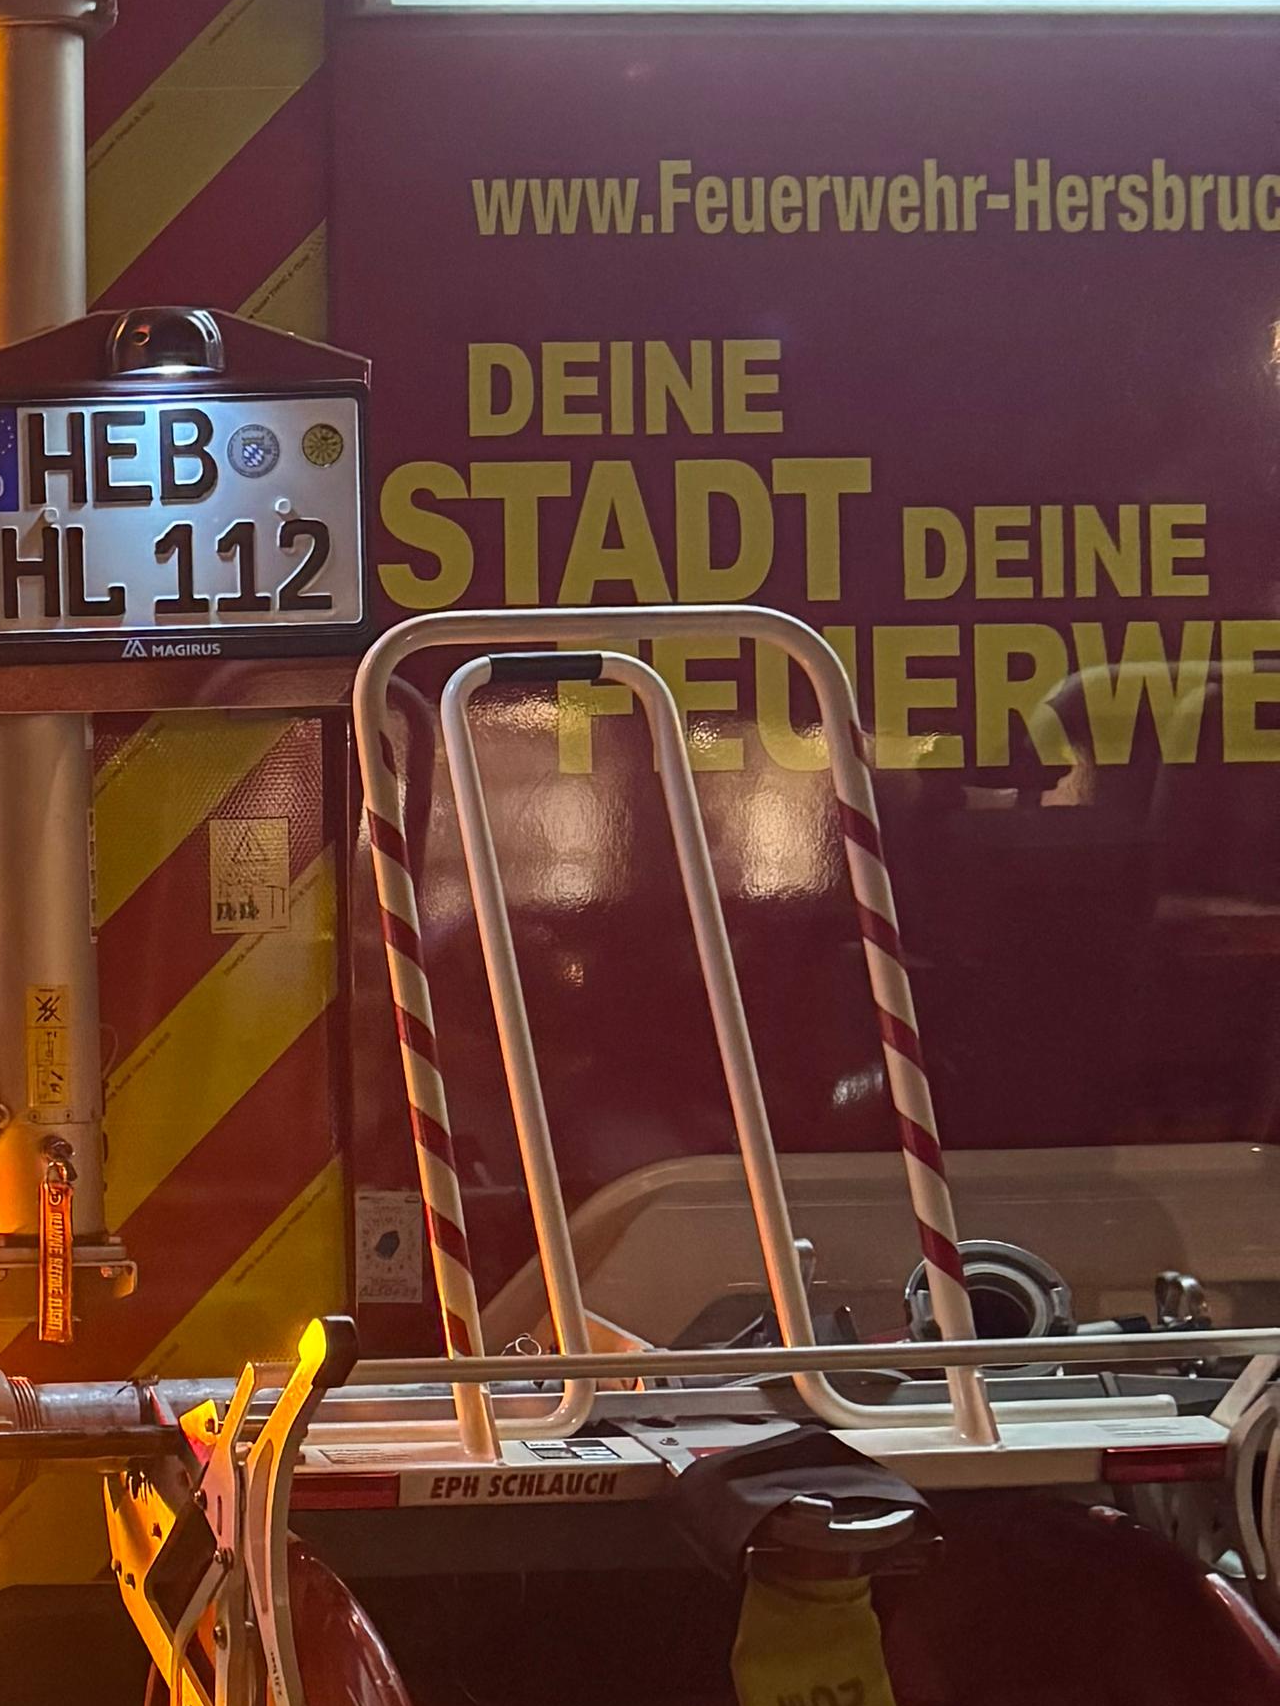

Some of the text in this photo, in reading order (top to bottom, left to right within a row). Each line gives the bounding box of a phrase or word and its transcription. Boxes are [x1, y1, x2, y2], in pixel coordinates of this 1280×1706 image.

[468, 339, 784, 436] DEINE
[27, 408, 219, 505] HEB
[1, 518, 334, 620] HL 112
[377, 456, 1209, 611] STADT DEINE
[152, 642, 221, 658] MAGIRUS
[430, 1472, 618, 1500] EPH SCHLAUCH
